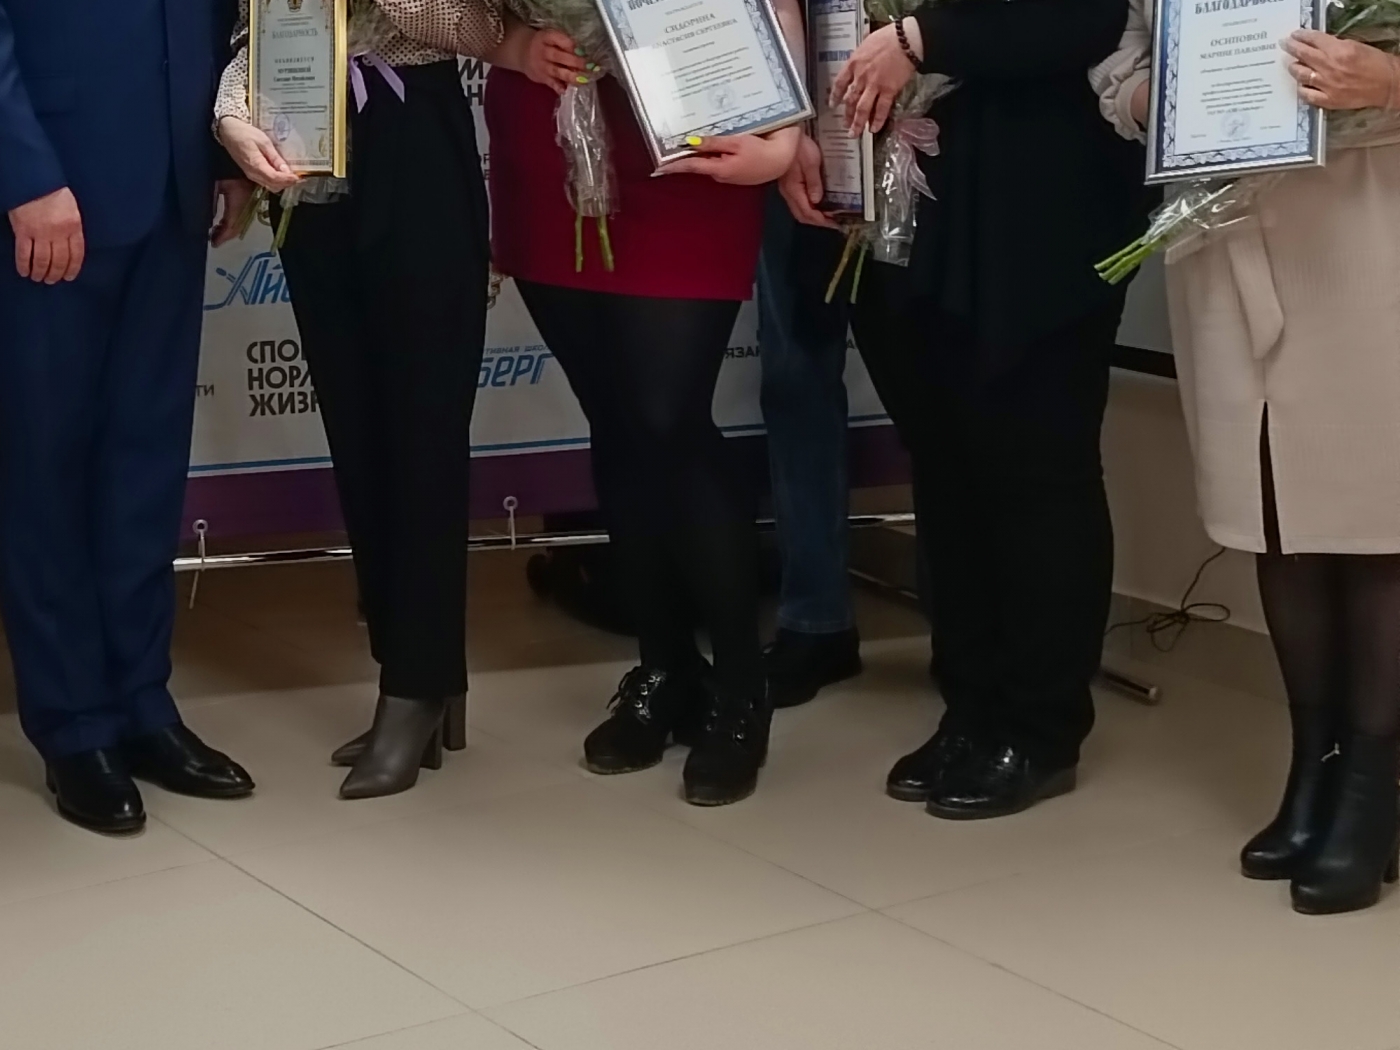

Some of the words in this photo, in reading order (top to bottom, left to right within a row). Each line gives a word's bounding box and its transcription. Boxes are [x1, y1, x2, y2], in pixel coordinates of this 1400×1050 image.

[246, 339, 304, 364] СПО
[247, 365, 311, 391] НОР
[477, 353, 554, 388] БЕРГ
[249, 391, 318, 417] ЖИЗ
